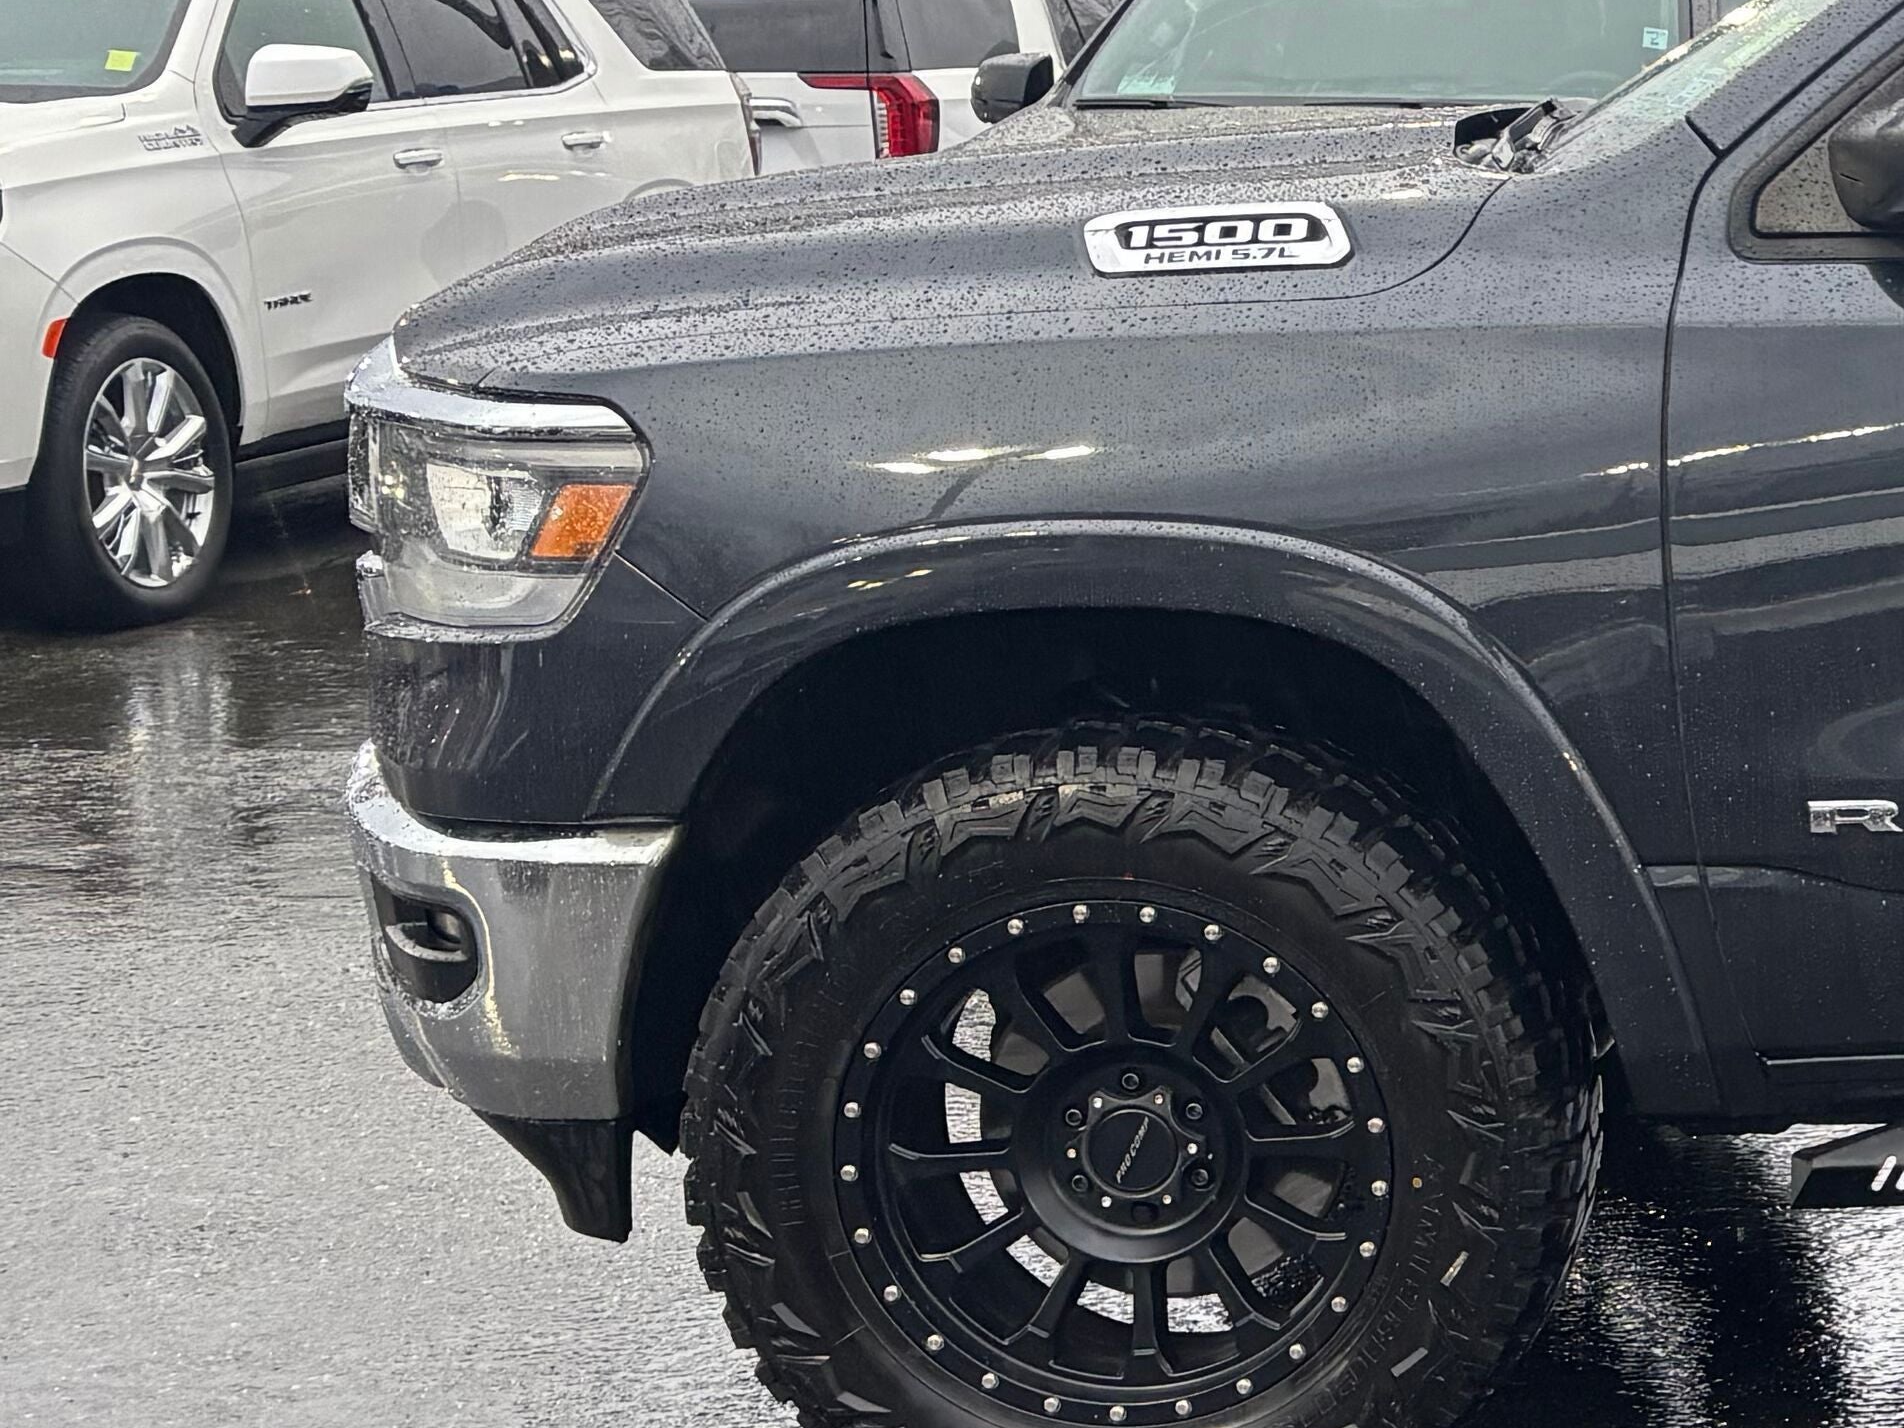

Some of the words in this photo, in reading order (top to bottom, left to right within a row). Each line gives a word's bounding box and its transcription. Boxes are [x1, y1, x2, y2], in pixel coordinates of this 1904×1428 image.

[1128, 218, 1309, 249] 1500
[1144, 249, 1221, 265] HEMI
[1231, 246, 1301, 262] 5.7L
[1116, 1153, 1131, 1184] PRO
